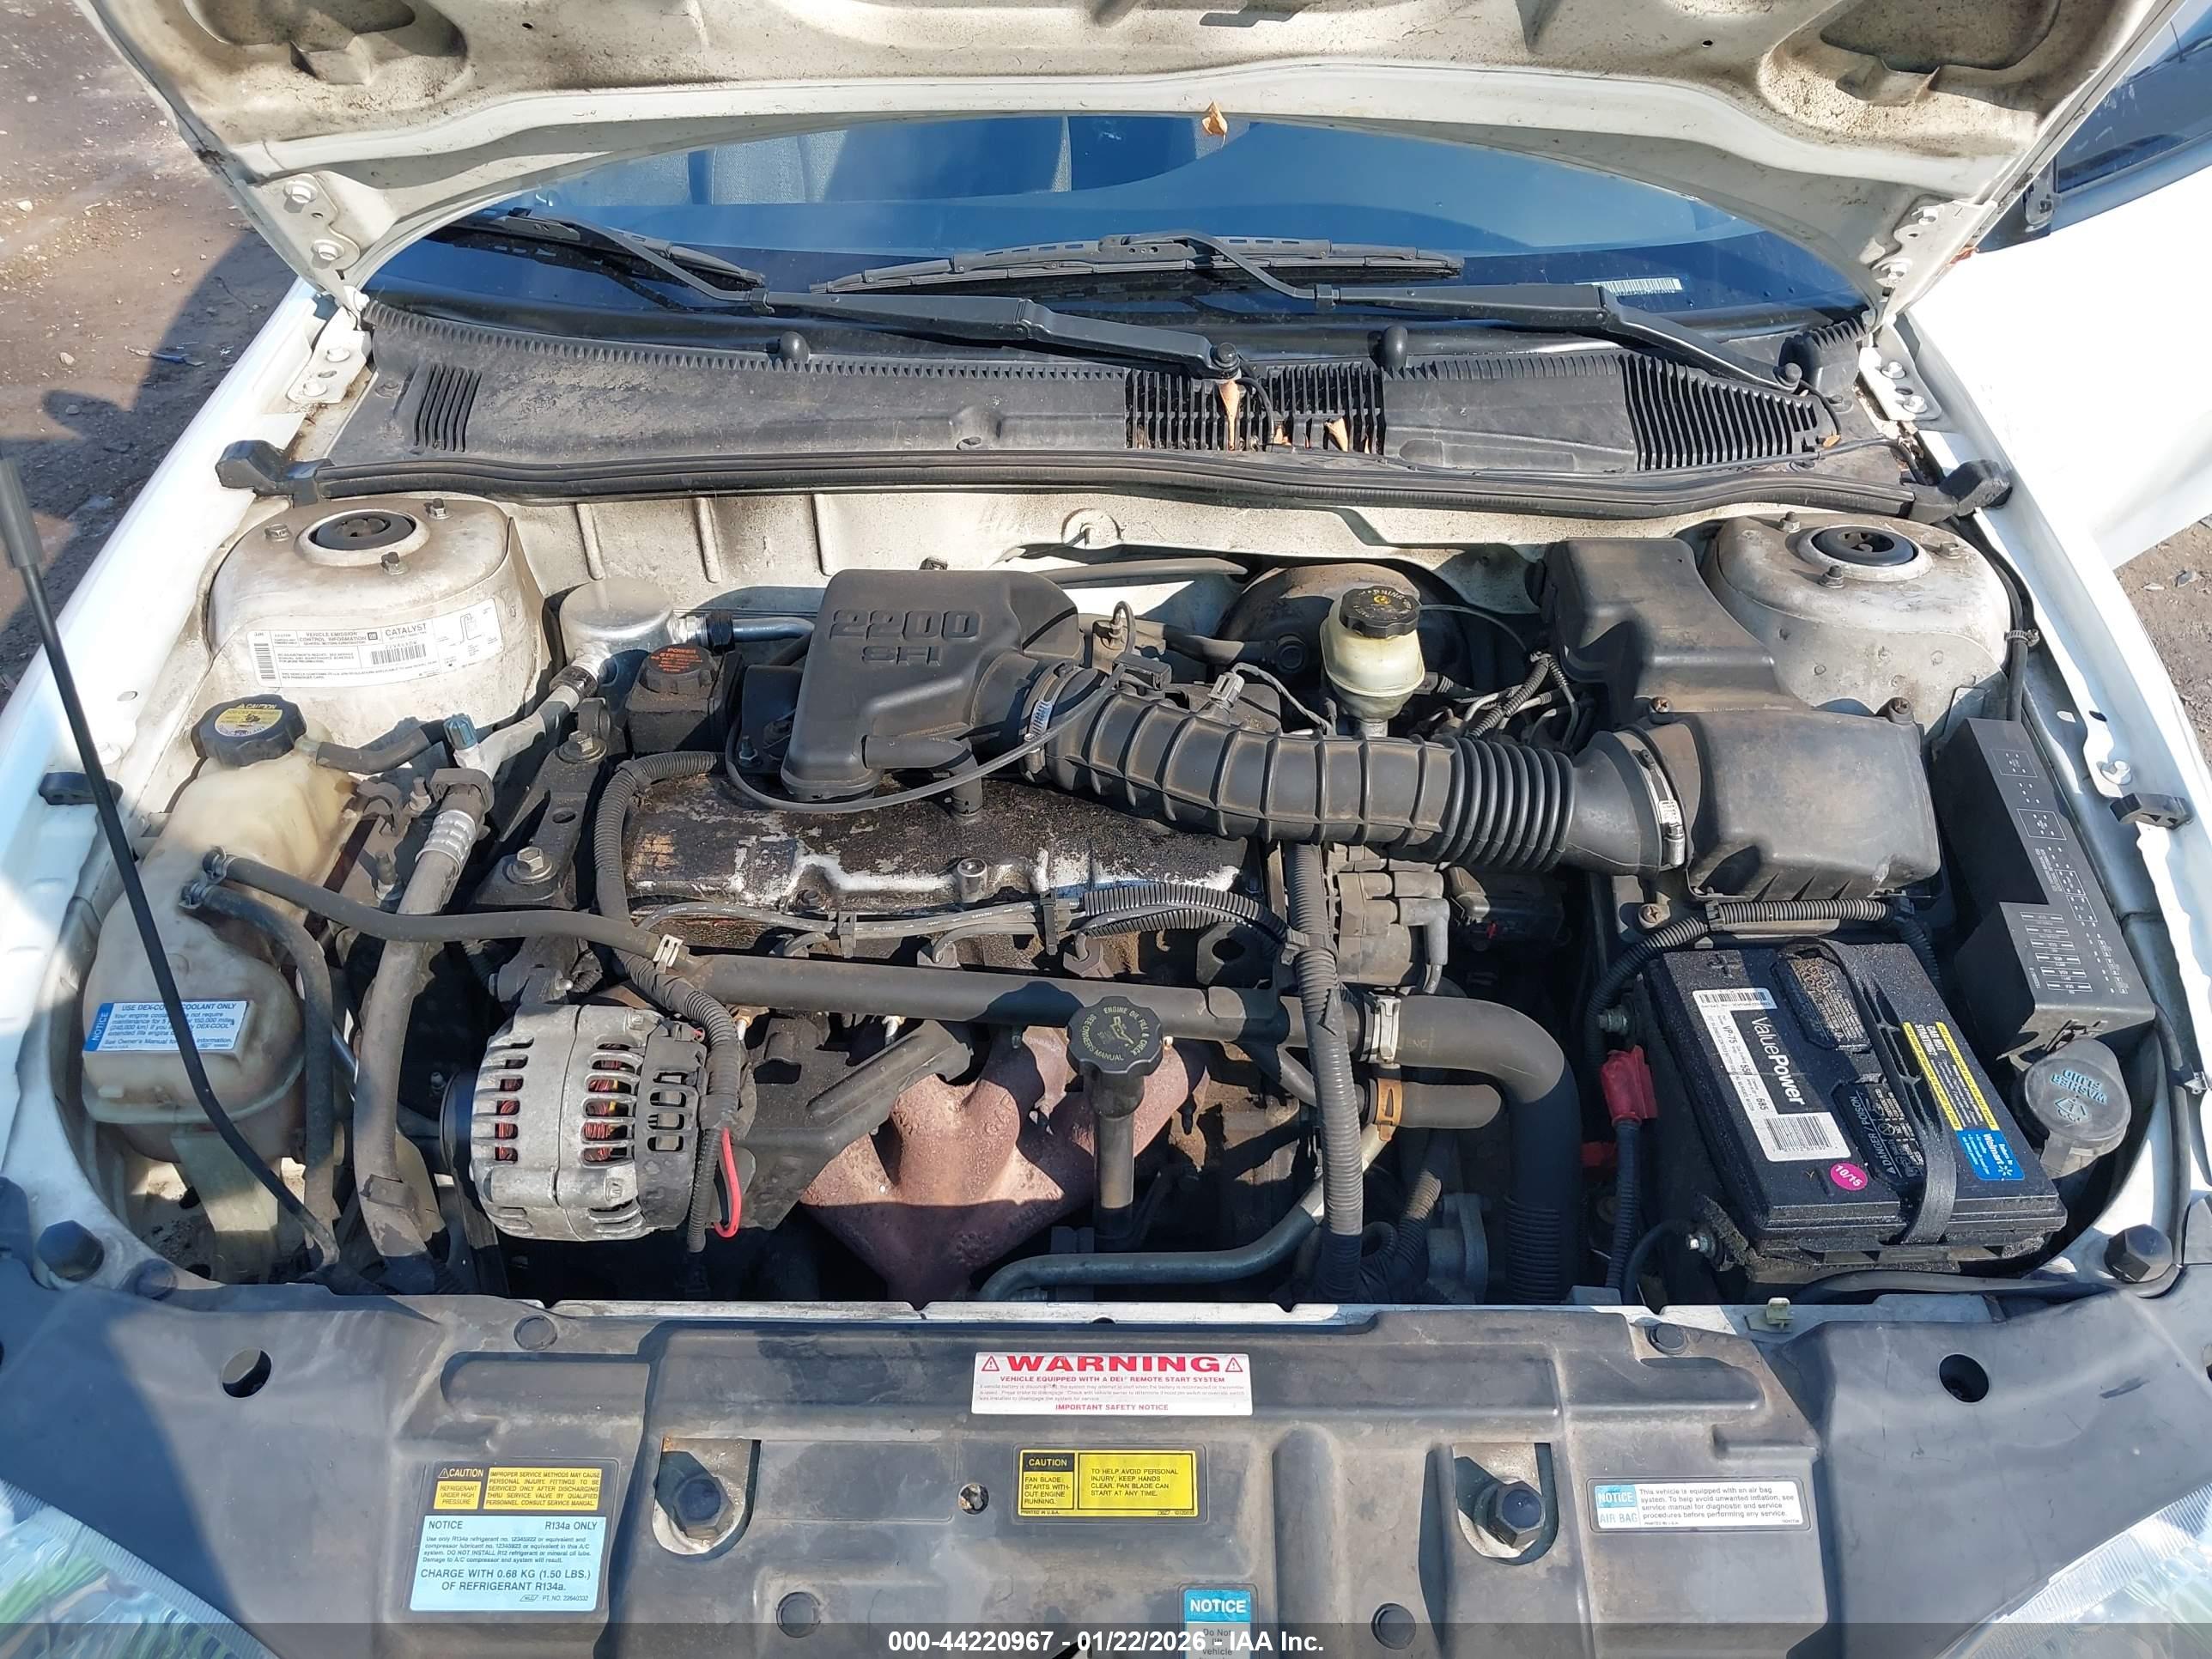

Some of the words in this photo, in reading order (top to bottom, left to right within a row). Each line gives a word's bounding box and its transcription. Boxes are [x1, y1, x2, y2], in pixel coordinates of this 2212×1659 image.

[385, 623, 427, 636] CATALYST
[830, 610, 981, 642] 2200
[861, 645, 942, 667] SFI
[1129, 1010, 1140, 1020] OIL
[92, 1012, 108, 1042] NOTICE
[1139, 1017, 1149, 1030] FILL
[1084, 1013, 1097, 1025] SEE
[1093, 1048, 1125, 1061] MANUAL
[1723, 1025, 1738, 1044] VP-75
[1130, 1040, 1148, 1056] CHECK
[1752, 1017, 1806, 1106] ValuePower
[1756, 1097, 1769, 1111] 685
[1849, 1096, 1871, 1125] POISON
[1868, 1133, 1893, 1166] DANGER
[1984, 1133, 2004, 1164] Walmart
[1834, 1164, 1863, 1187] 10/15
[1006, 1355, 1220, 1372] WARNING
[1029, 1458, 1067, 1467] CAUTION
[448, 1468, 484, 1477] CAUTION
[1598, 1492, 1633, 1503] NOTICE
[428, 1520, 464, 1529] NOTICE
[1600, 1513, 1616, 1523] AIR
[1619, 1513, 1638, 1523] BAG
[544, 1522, 570, 1530] R134a
[574, 1522, 598, 1530] ONLY
[421, 1569, 465, 1578] CHARGE
[467, 1569, 495, 1578] WITH
[496, 1570, 517, 1578] 0.68
[520, 1570, 536, 1578] KG
[539, 1570, 562, 1580] (1.50
[565, 1570, 591, 1580] LBS.)
[441, 1582, 457, 1590] OF
[459, 1582, 532, 1590] REFRIGERANT
[535, 1582, 567, 1591] R134a.
[1190, 1599, 1247, 1613] NOTICE
[1217, 1628, 1231, 1637] Not
